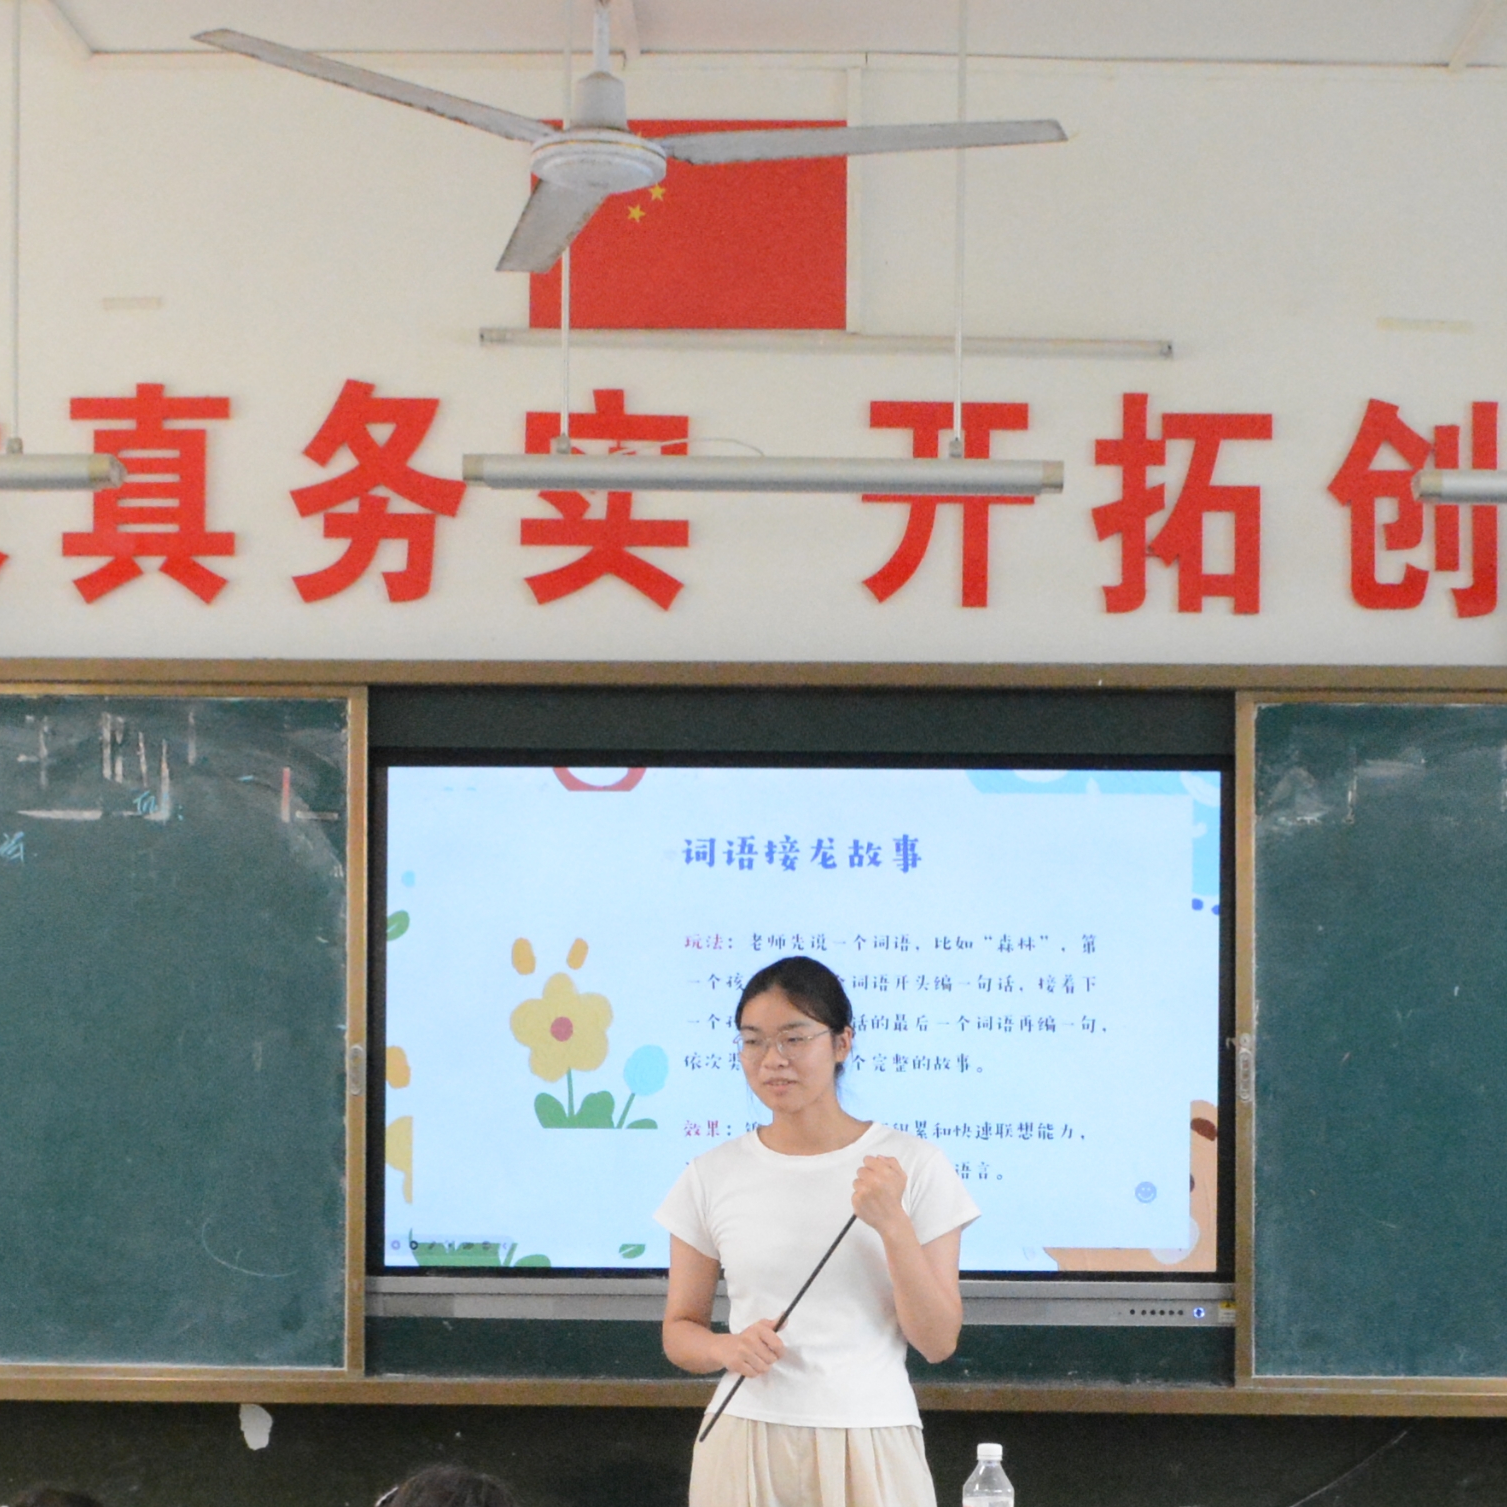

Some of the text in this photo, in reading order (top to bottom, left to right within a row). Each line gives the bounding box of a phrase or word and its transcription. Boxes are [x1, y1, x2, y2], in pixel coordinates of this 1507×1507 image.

[681, 834, 924, 873] 词语接龙故事
